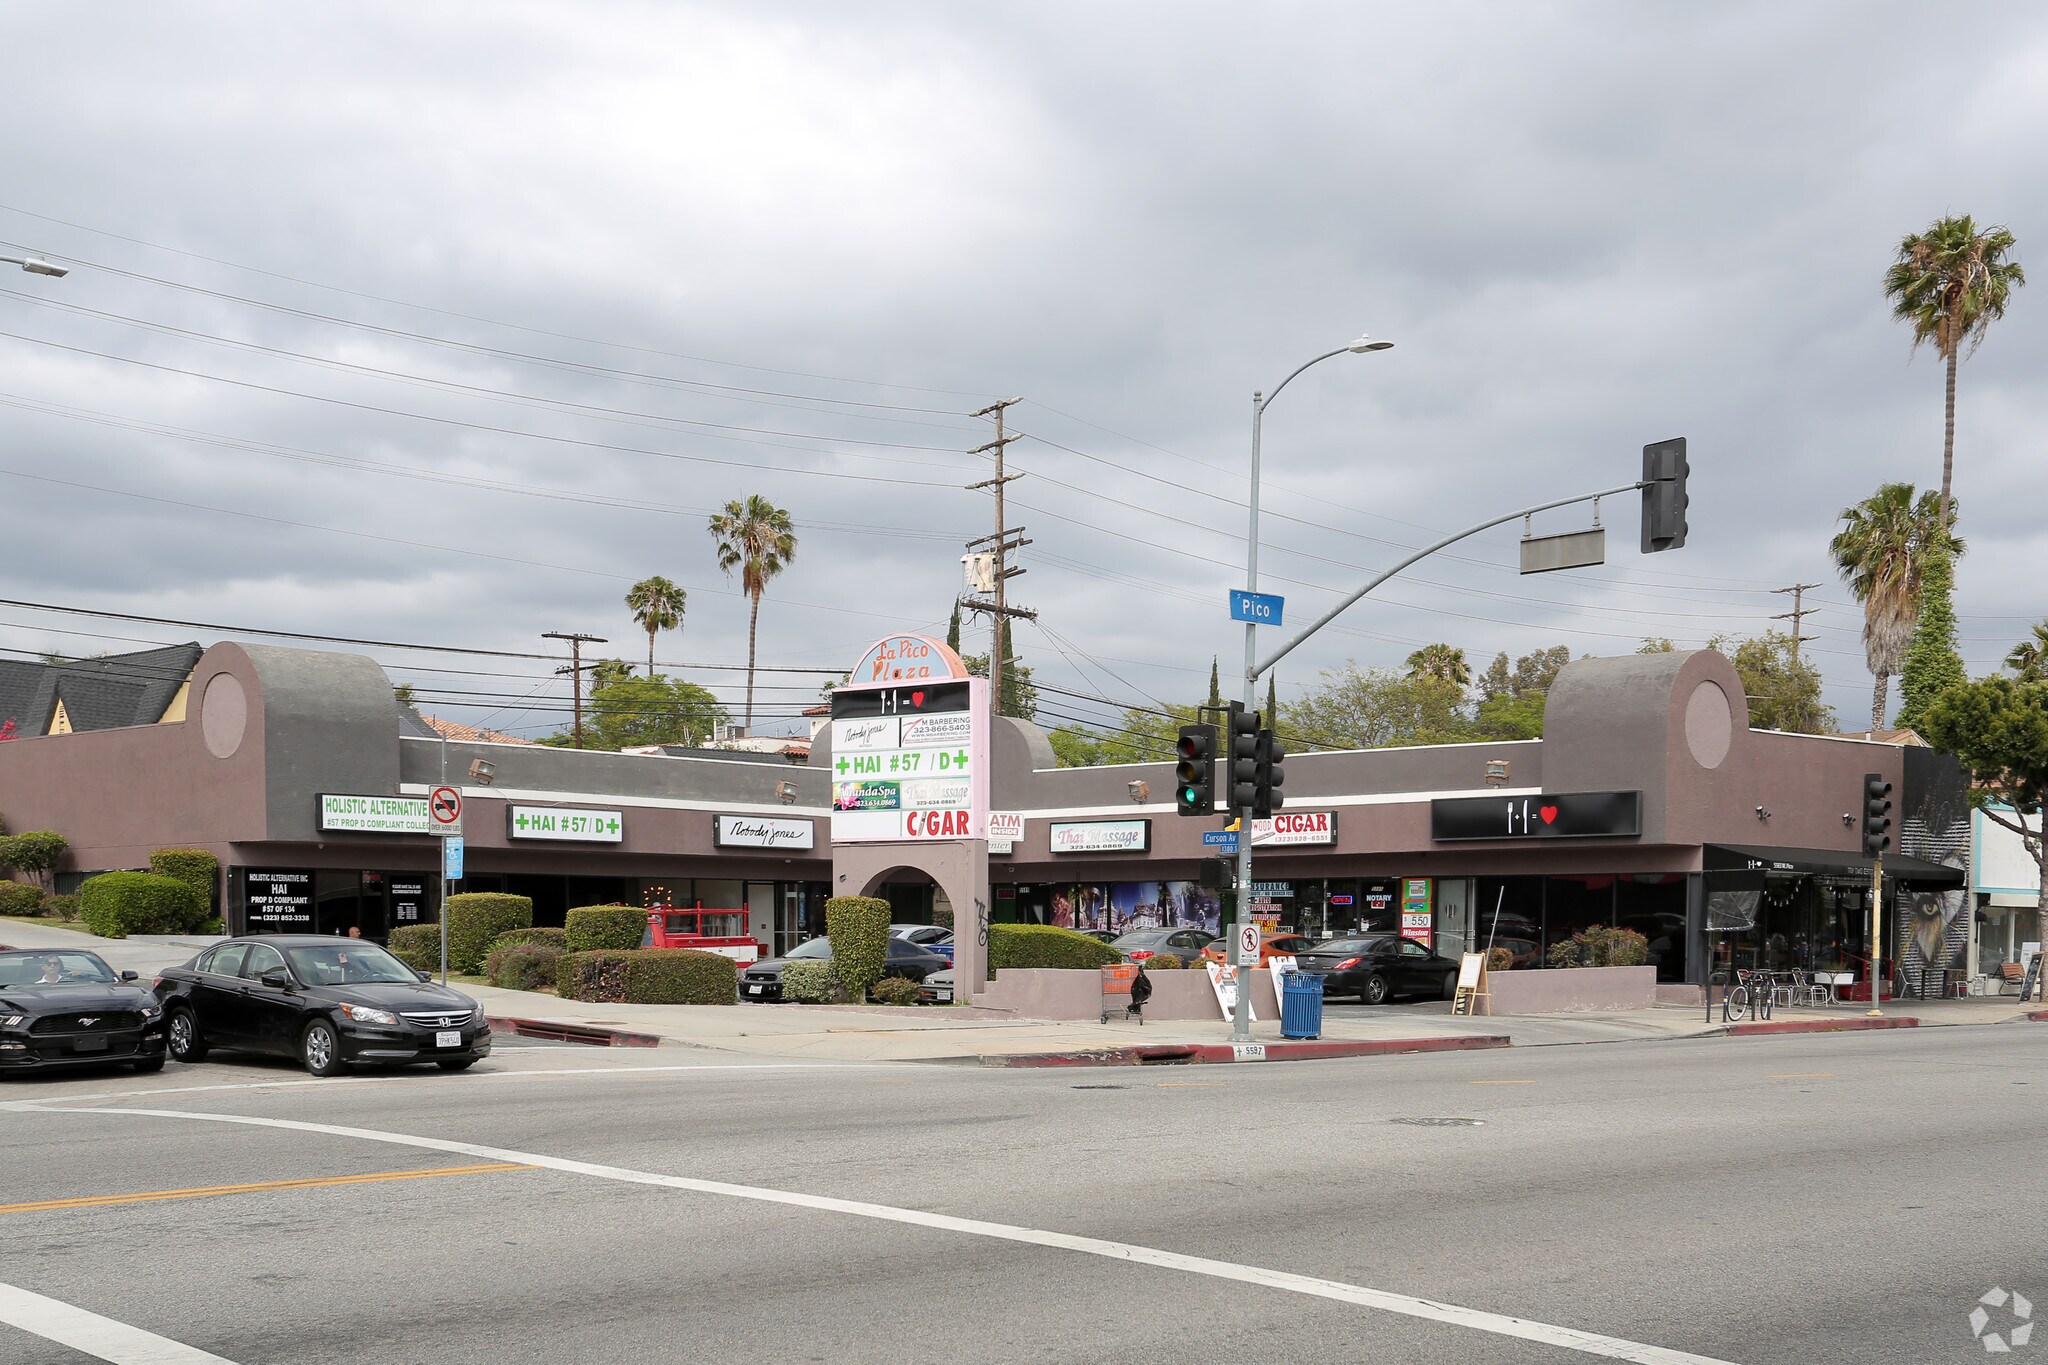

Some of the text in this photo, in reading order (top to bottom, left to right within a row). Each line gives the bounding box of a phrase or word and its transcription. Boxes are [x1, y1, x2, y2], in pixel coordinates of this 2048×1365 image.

[1242, 598, 1270, 618] Pico
[875, 639, 929, 661] La Pico
[872, 660, 930, 682] Plaza
[929, 716, 971, 726] BARBERING
[913, 724, 971, 734] 323-866-5403
[854, 755, 881, 774] HAI
[325, 797, 428, 817] HOLISTIC ALTERNATIVE
[327, 818, 339, 826] #57
[341, 818, 359, 828] PROP
[366, 820, 404, 829] COMPLIANT
[406, 821, 430, 830] COLLEC
[531, 814, 556, 831] HAI
[990, 814, 1020, 827] ATM
[1251, 813, 1329, 833] WOOD CIGAR
[730, 821, 769, 845] Nobody
[1058, 827, 1139, 847] Thai Massage
[1205, 833, 1236, 843] Curson Av
[249, 874, 270, 882] HOLISTIC
[271, 874, 300, 882] ALTERNATIVE
[271, 884, 287, 894] HAI
[1251, 882, 1290, 891] NSURANCE
[250, 896, 267, 904] PROP
[1366, 894, 1392, 902] NOTARY
[1403, 928, 1429, 937] Winston
[1245, 1044, 1262, 1055] 5597
